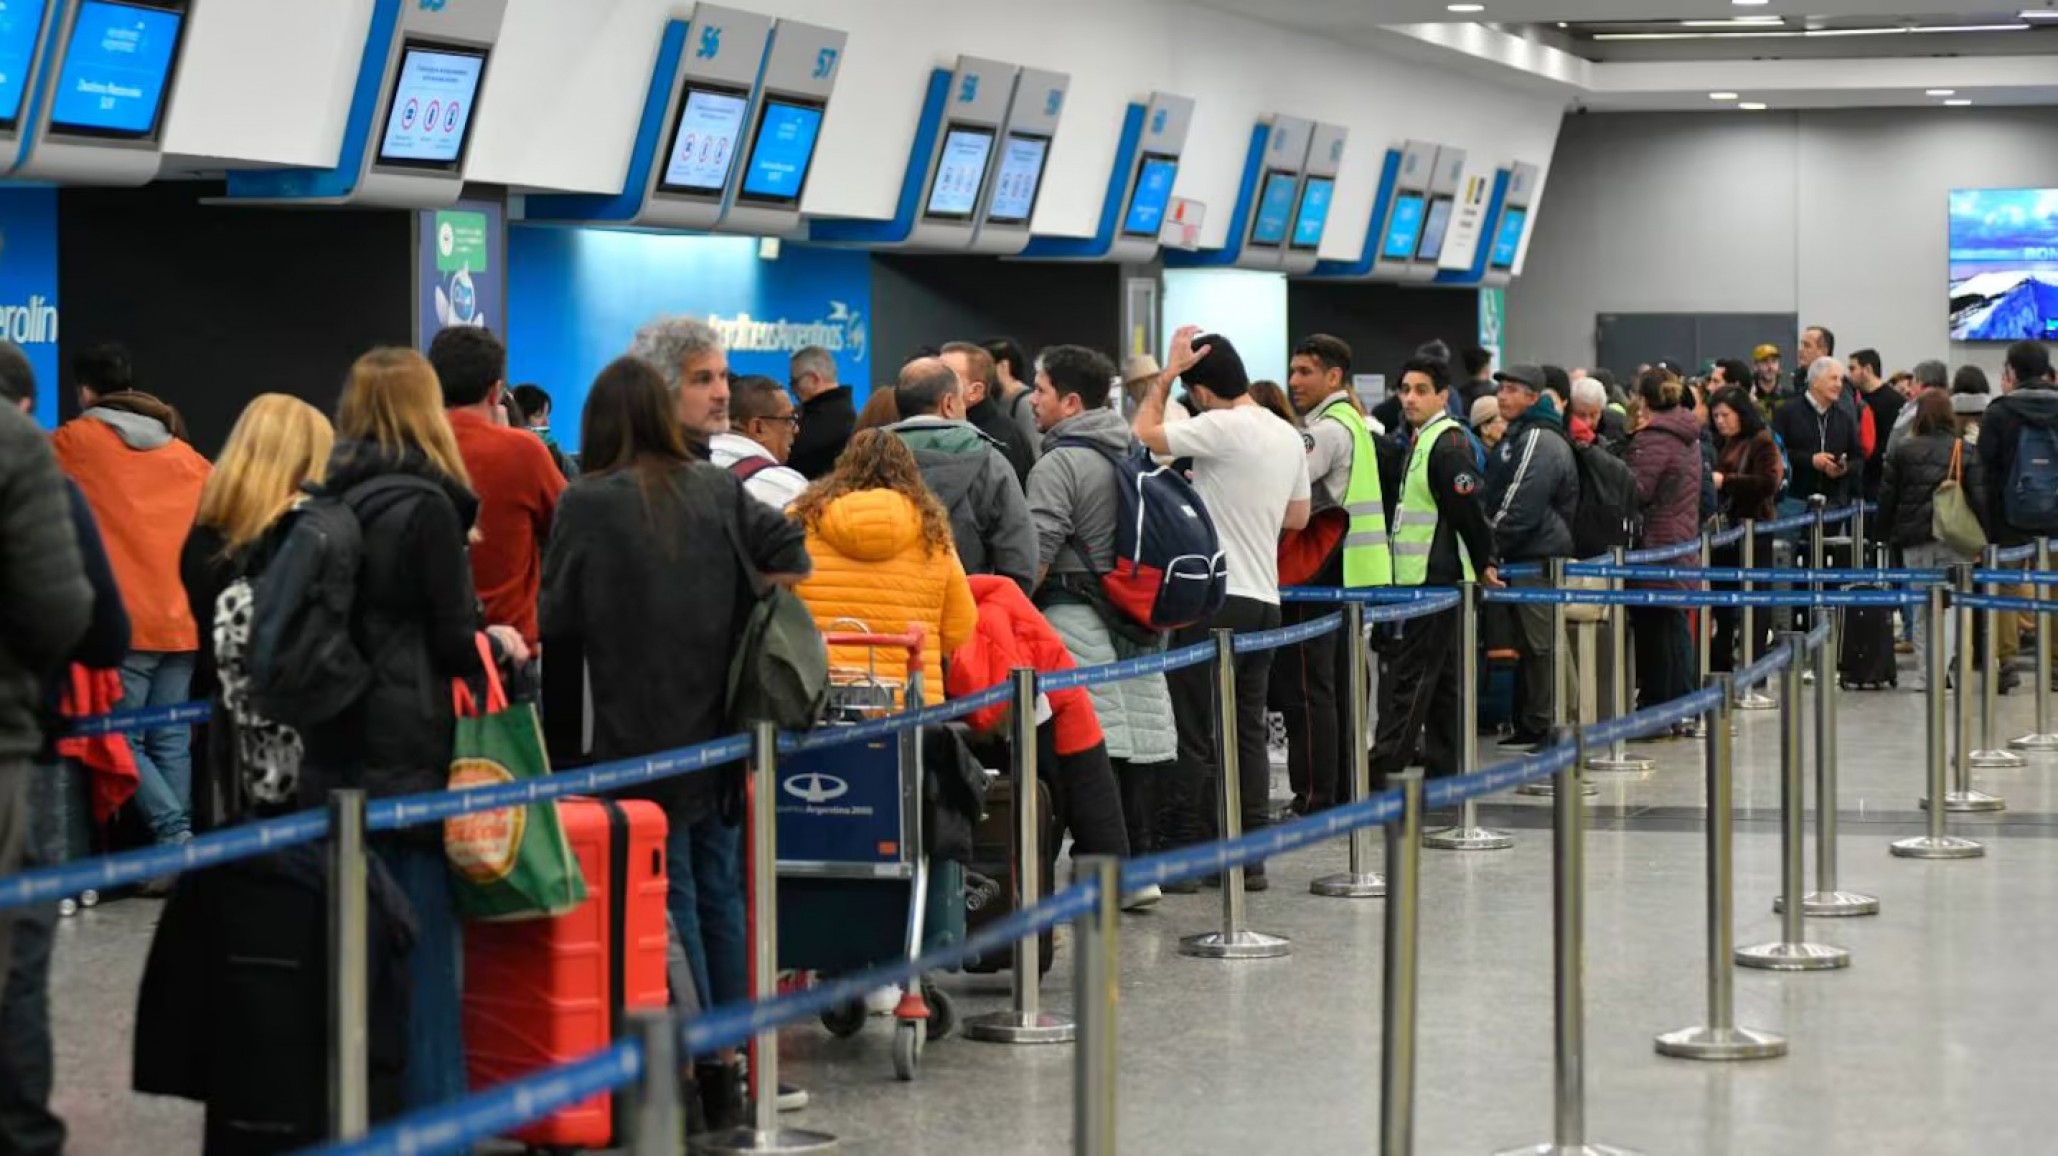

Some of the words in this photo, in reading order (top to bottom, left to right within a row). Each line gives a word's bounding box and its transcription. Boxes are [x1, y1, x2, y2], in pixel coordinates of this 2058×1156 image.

[696, 26, 722, 59] 56
[812, 48, 837, 79] 57
[806, 805, 850, 815] Argentina
